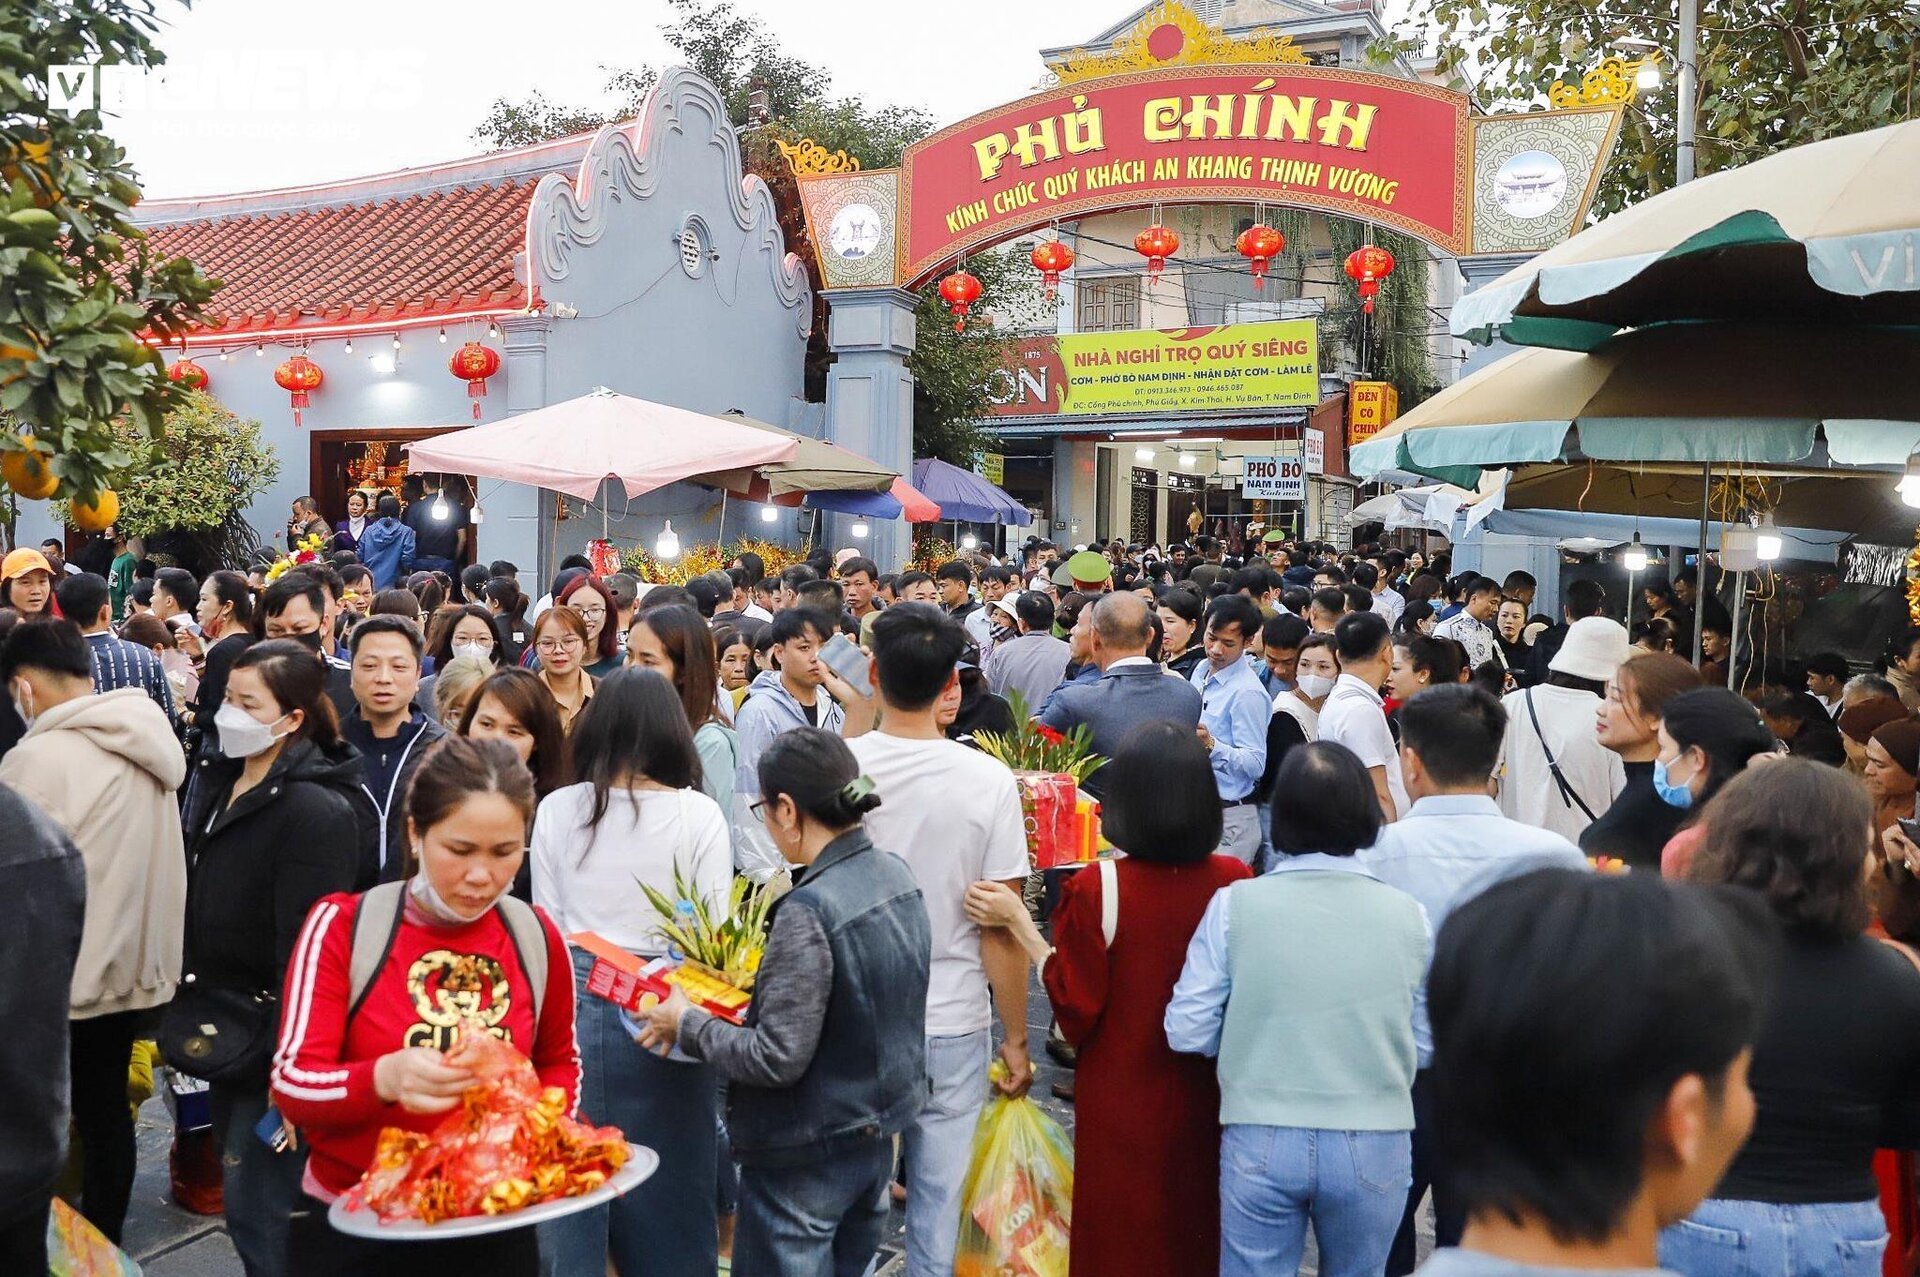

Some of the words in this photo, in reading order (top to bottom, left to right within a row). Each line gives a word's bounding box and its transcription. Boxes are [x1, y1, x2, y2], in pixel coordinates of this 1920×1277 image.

[972, 94, 1108, 183] PHỦ
[1144, 78, 1380, 153] CHÍNH
[946, 199, 990, 233] KÍNH
[993, 180, 1039, 214] CHÚC
[1043, 168, 1079, 200] QUÝ
[1086, 157, 1145, 190] KHÁCH
[1153, 157, 1179, 181] AN
[1186, 156, 1253, 180] KHANG
[1260, 157, 1322, 190] THỊNH
[1327, 166, 1400, 205] VƯỢNG
[1024, 351, 1041, 360] 1875
[1074, 347, 1112, 367] NHÀ
[1116, 344, 1161, 365] NGHỈ
[1165, 346, 1202, 366] TRỌ
[1206, 339, 1247, 360] QUÝ
[1251, 337, 1308, 358] SIÊNG
[1070, 376, 1093, 386] CƠM
[1100, 372, 1121, 384] PHỞ
[1123, 372, 1136, 383] BÒ
[1138, 373, 1160, 383] NAM
[1162, 371, 1186, 384] ĐỊNH
[1193, 367, 1222, 381] NHẬN
[1223, 366, 1242, 379] ĐẶT
[1244, 367, 1269, 377] CƠM
[1277, 364, 1299, 375] LÀM
[1247, 456, 1277, 478] PHỞ
[1280, 457, 1302, 478] BÒ
[1247, 479, 1272, 488] NAM
[1275, 480, 1301, 490] ĐỊNH
